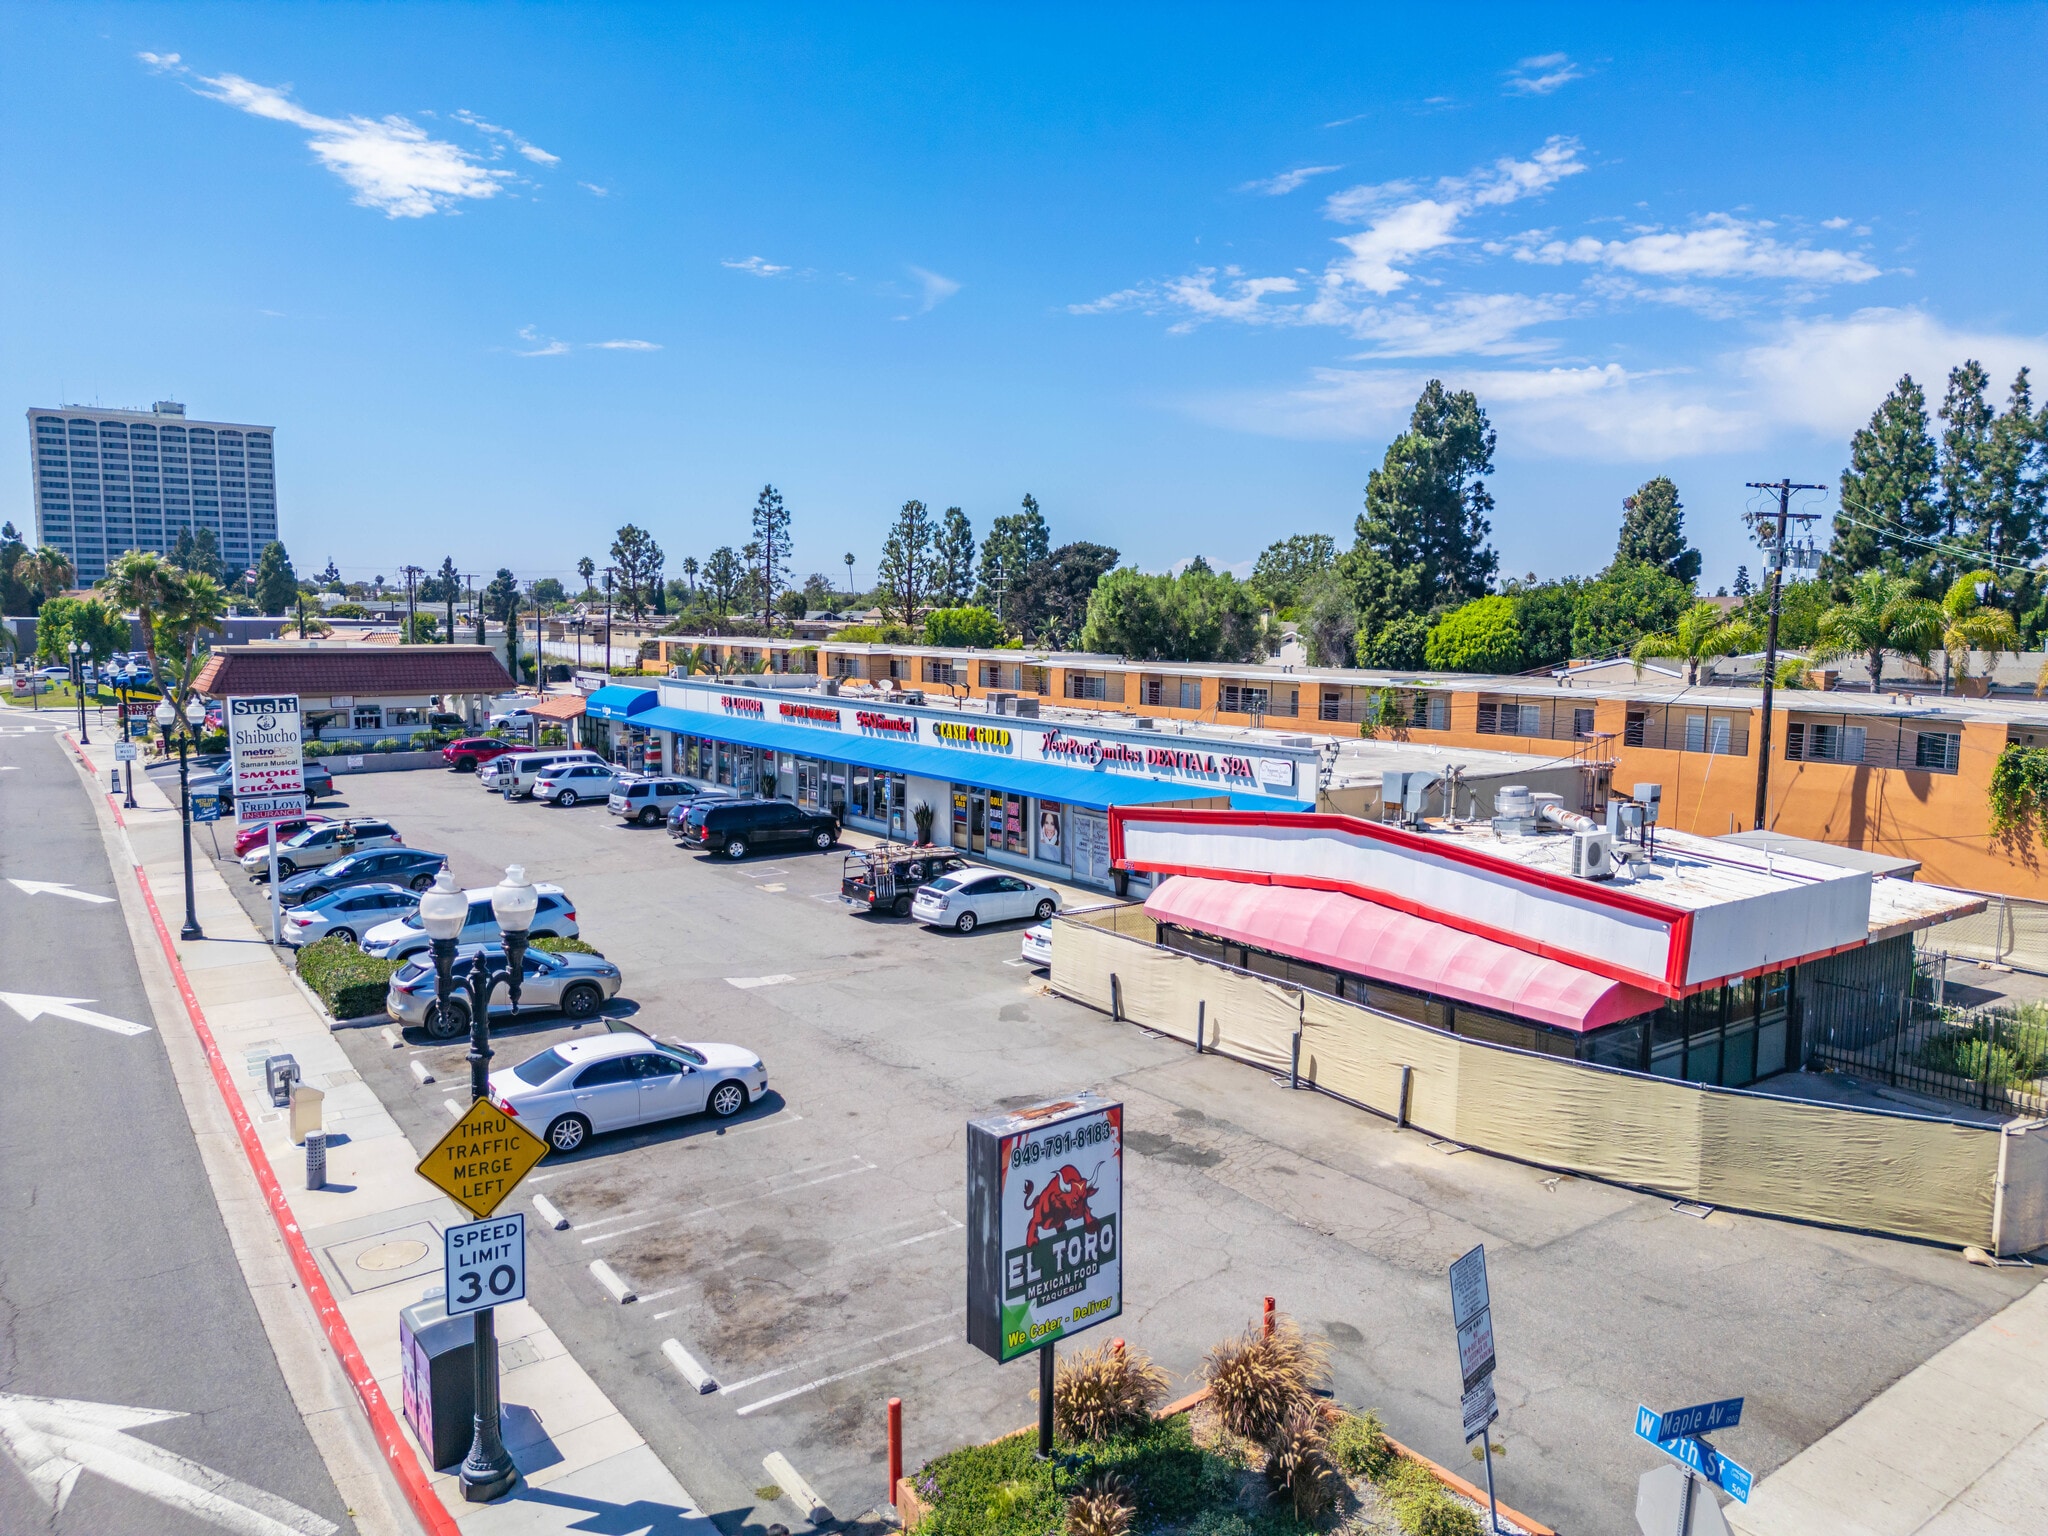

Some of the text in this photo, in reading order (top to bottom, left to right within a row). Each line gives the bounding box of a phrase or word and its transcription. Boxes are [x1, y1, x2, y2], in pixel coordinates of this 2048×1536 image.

[234, 698, 296, 715] Sushi
[732, 697, 761, 712] LIQUOR
[236, 728, 297, 745] Shibucho
[242, 746, 294, 757] metroPCS
[1145, 747, 1217, 773] DENTAL
[1220, 756, 1252, 778] SPA
[239, 768, 300, 779] SMOKE
[240, 759, 298, 769] Samara Musical
[239, 782, 302, 793] CIGARS
[241, 799, 302, 813] FRED LOYA
[242, 809, 301, 820] INSURANCE
[460, 1119, 506, 1138] THRU
[446, 1136, 520, 1161] TRAFFIC
[1011, 1120, 1110, 1169] 949-791-8183
[454, 1157, 513, 1180] MERGE
[463, 1179, 505, 1199] LEFT
[453, 1223, 518, 1248] SPEED
[459, 1243, 512, 1268] LIMIT
[1008, 1223, 1114, 1289] EL TORO
[456, 1264, 516, 1304] 30
[1027, 1264, 1098, 1300] MEXICAN FOOD
[1041, 1282, 1083, 1303] TAQUERIA
[1008, 1330, 1026, 1348] We
[1029, 1320, 1062, 1339] Cater
[1072, 1296, 1113, 1323] Deliver
[1640, 1410, 1655, 1437] W
[1661, 1404, 1724, 1437] Maple Av
[1705, 1451, 1726, 1480] St
[1731, 1483, 1747, 1499] 500
